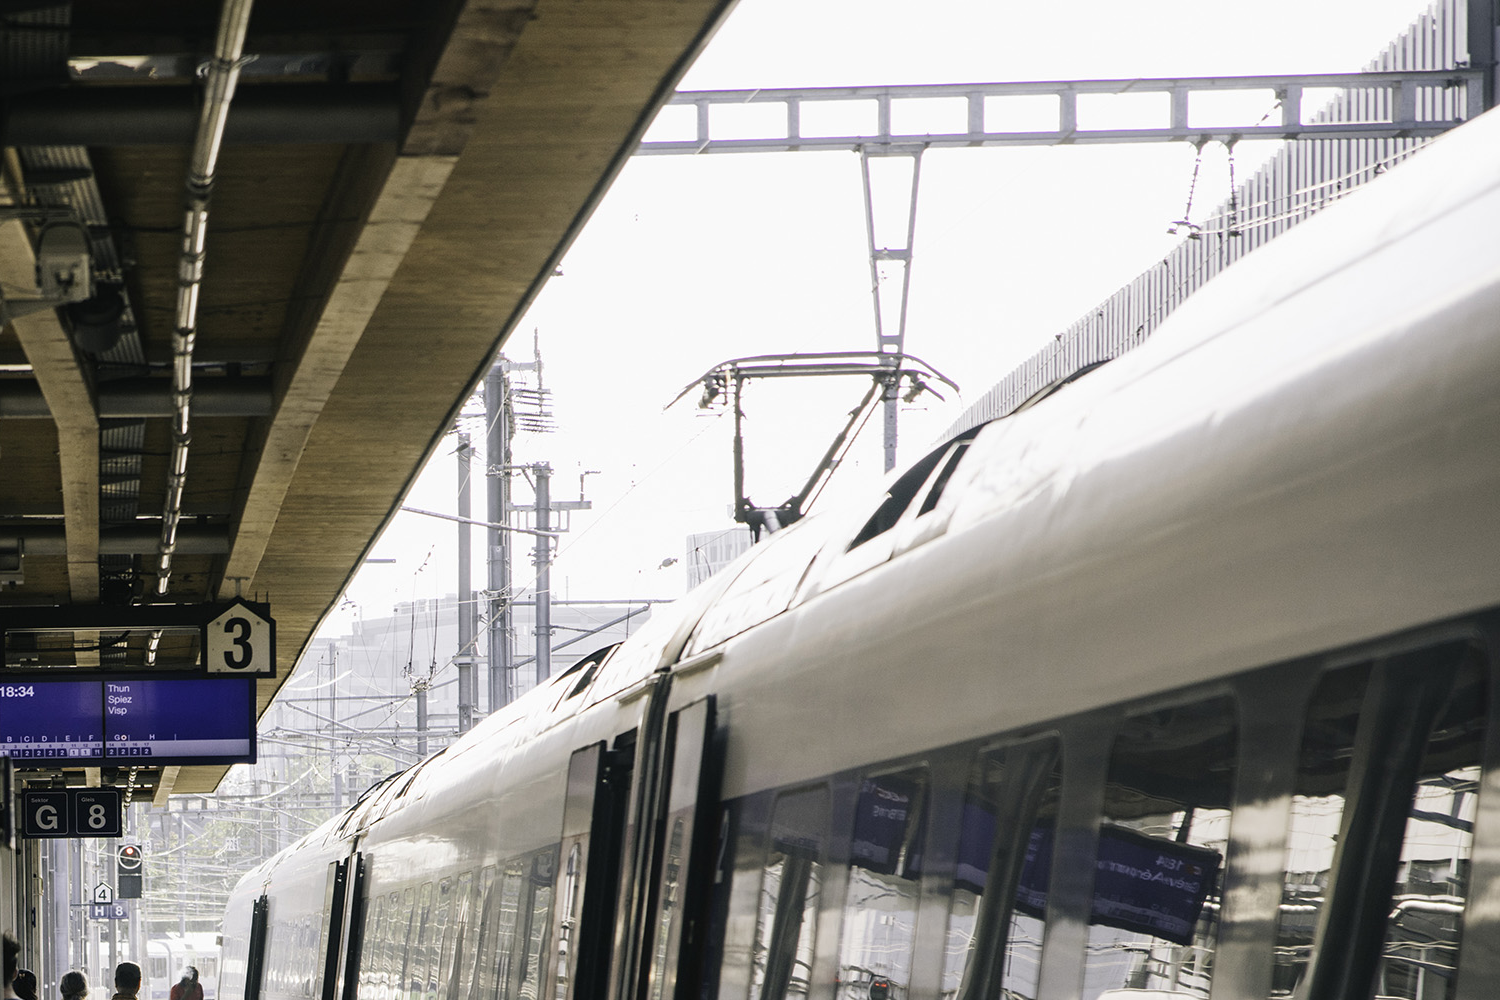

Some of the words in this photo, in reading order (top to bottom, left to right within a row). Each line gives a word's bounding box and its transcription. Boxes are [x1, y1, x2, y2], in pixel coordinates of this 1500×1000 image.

[223, 616, 253, 670] 3
[0, 686, 35, 697] 18:34
[108, 684, 130, 693] Thun
[108, 696, 132, 705] Spiez
[108, 706, 128, 716] Visp
[35, 804, 58, 830] G
[88, 804, 106, 829] 8
[98, 889, 107, 900] 4
[95, 907, 104, 917] H
[115, 906, 123, 916] 8
